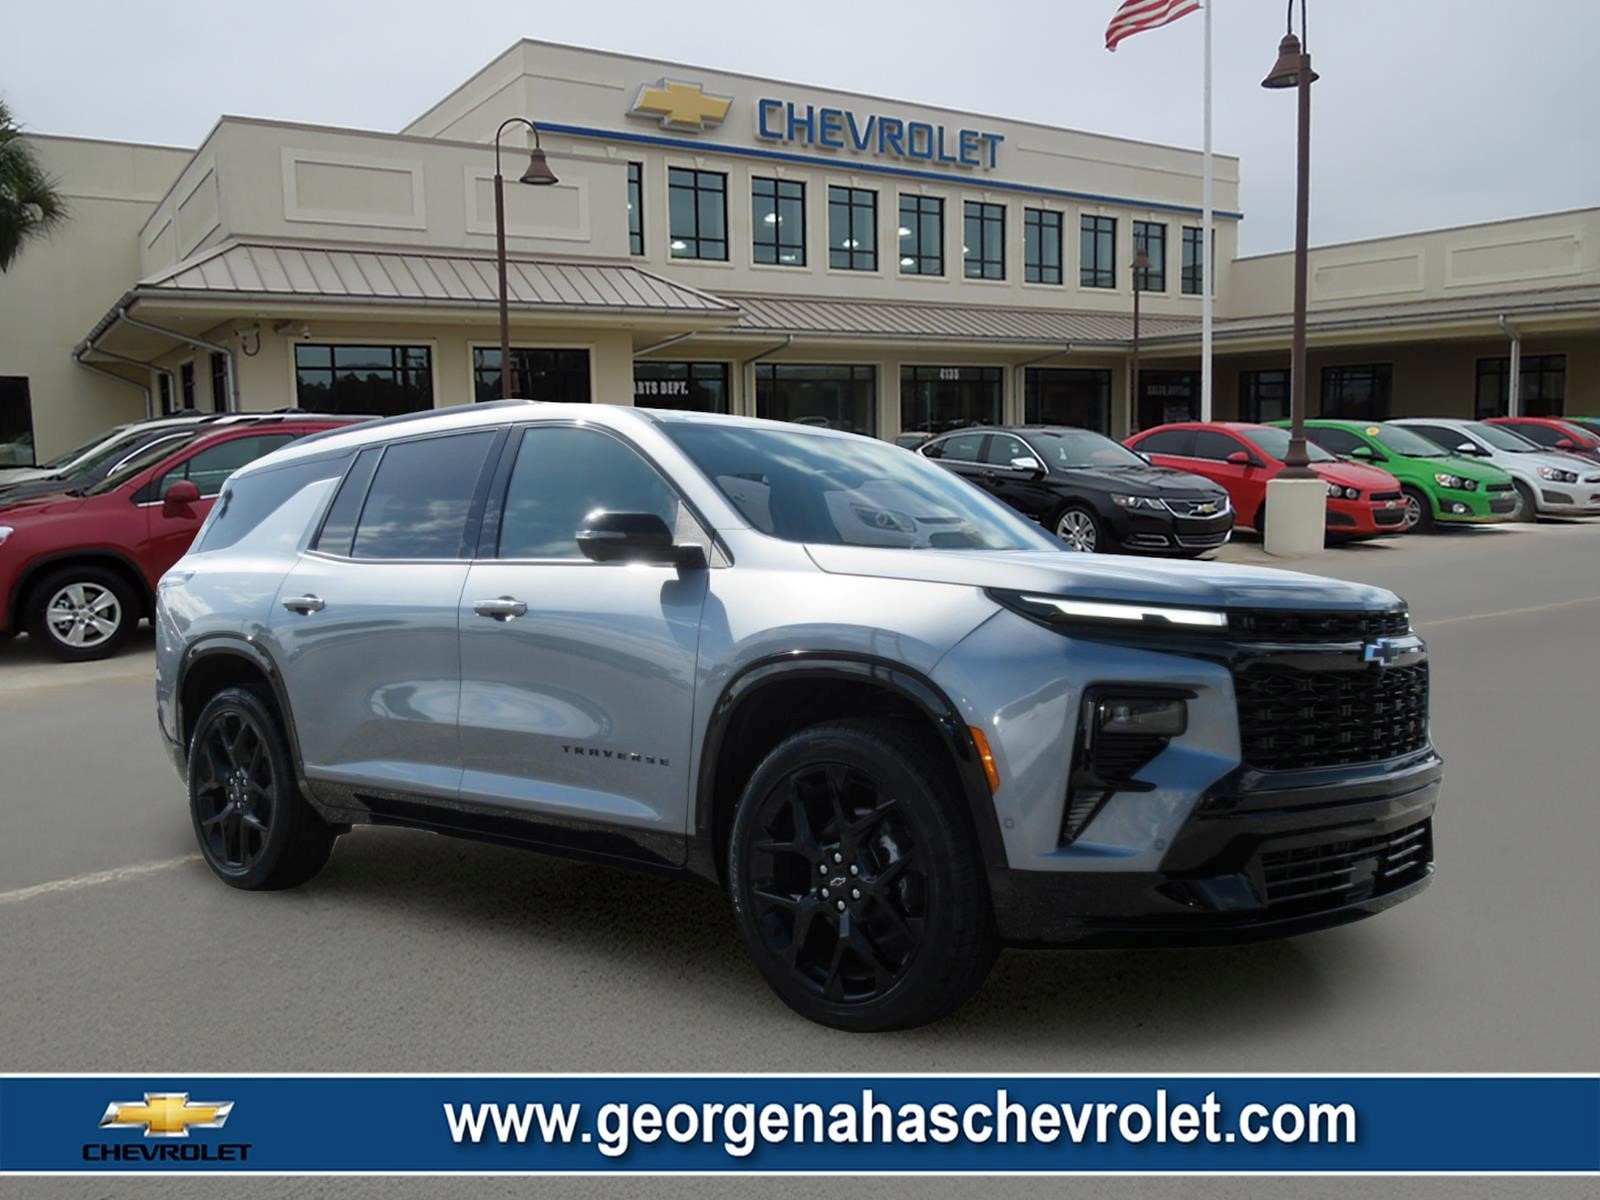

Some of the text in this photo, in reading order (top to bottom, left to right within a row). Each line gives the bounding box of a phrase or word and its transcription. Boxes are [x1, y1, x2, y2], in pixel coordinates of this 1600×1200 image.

[757, 98, 1005, 169] CHEVROLET
[660, 381, 689, 395] DEPT.
[561, 744, 671, 767] TRAVERSE
